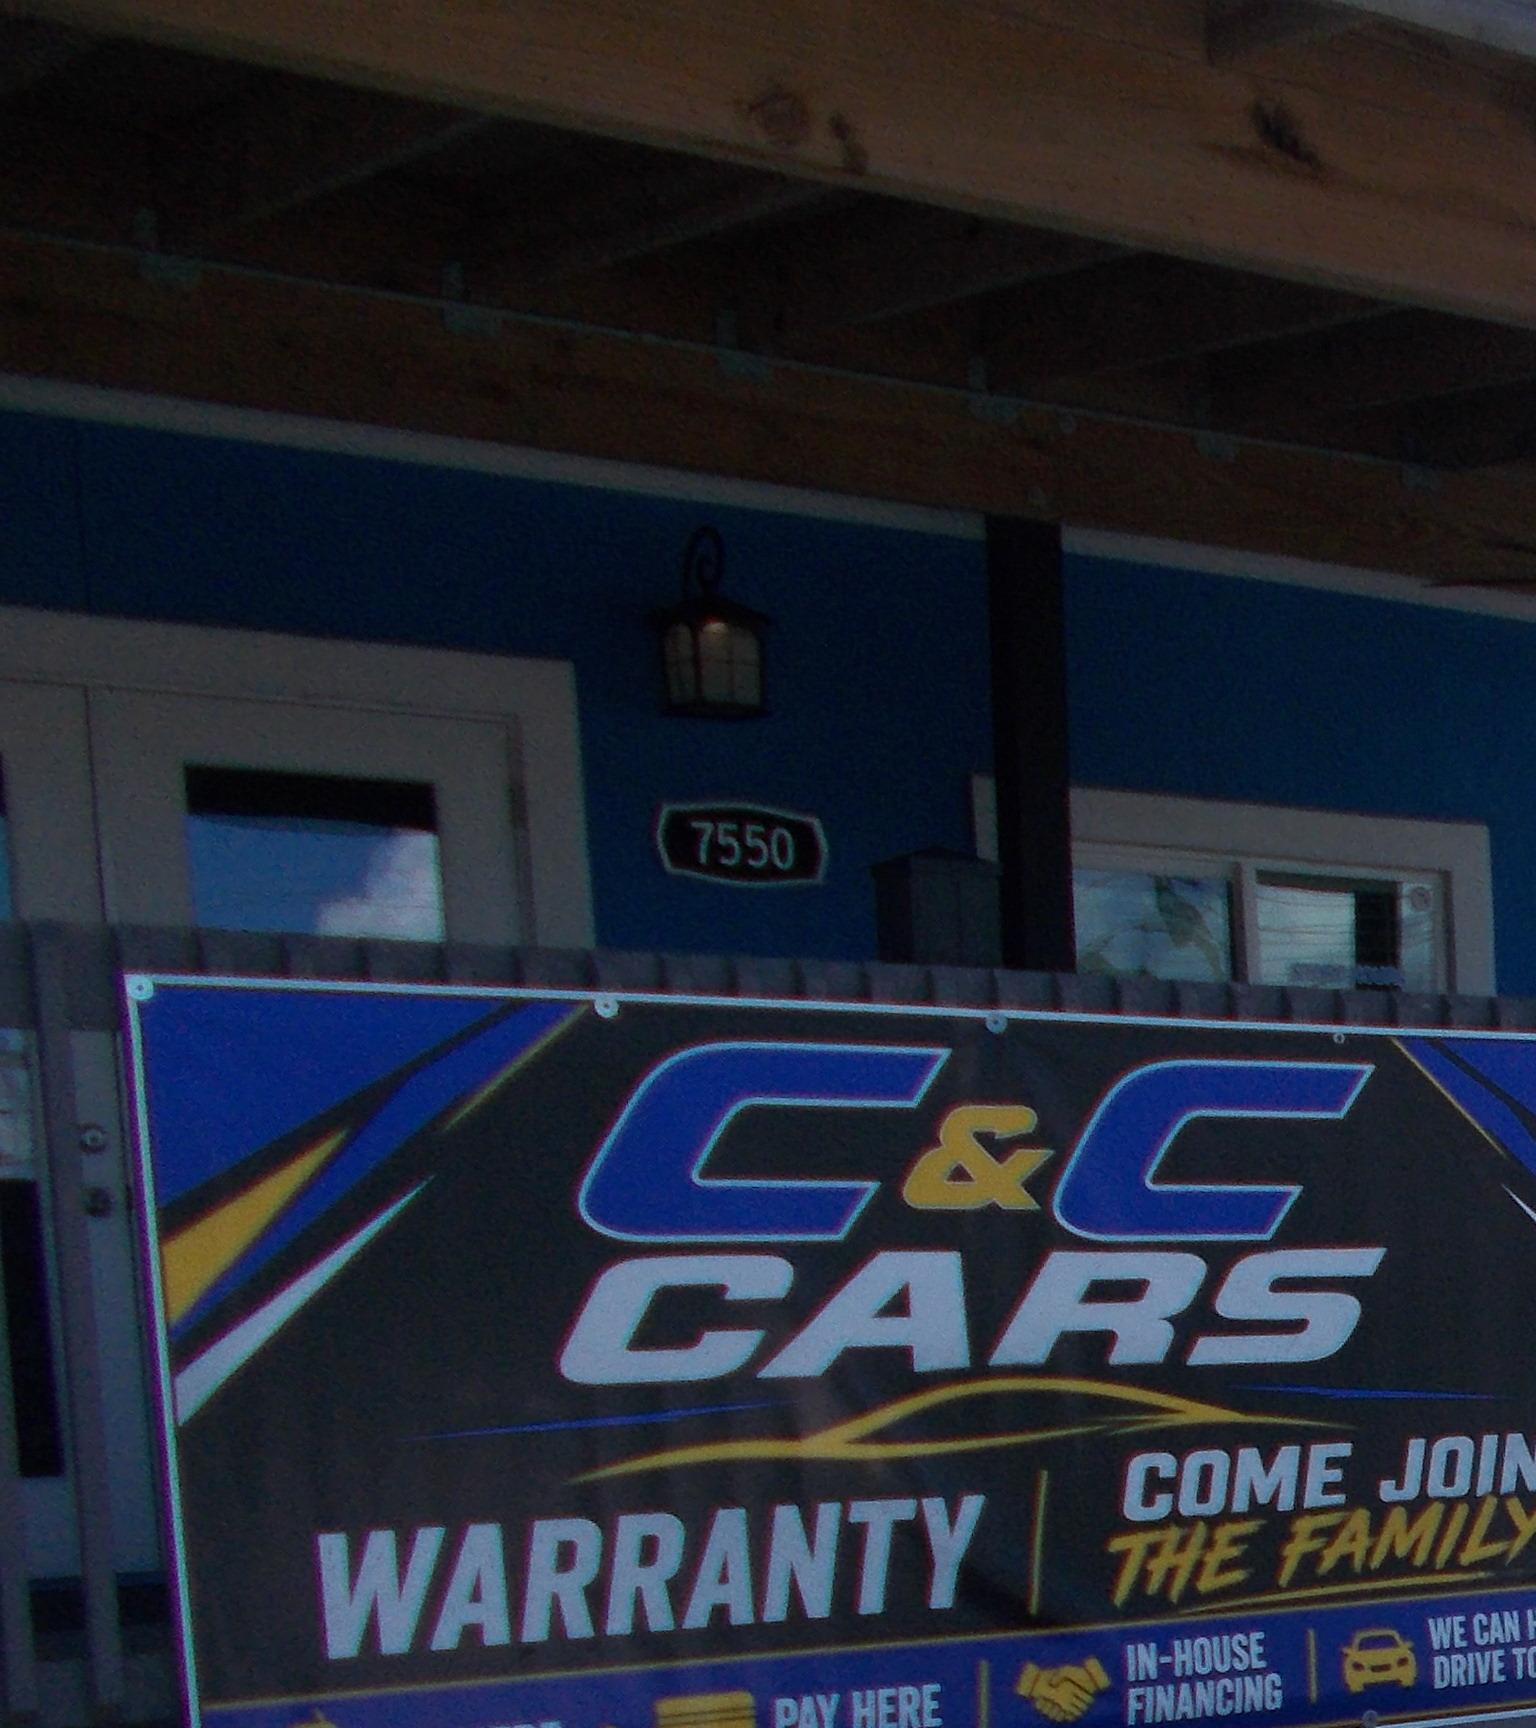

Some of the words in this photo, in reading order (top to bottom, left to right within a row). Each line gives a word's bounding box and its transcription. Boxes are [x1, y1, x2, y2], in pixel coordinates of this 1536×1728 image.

[690, 821, 795, 871] 7550
[577, 1041, 1376, 1243] C&C
[559, 1247, 1387, 1385] CARS
[1121, 1442, 1353, 1522] COME
[316, 1494, 986, 1661] WARRANTY
[1107, 1517, 1267, 1609] THE
[1126, 1632, 1267, 1682] IN-HOUSE
[1428, 1613, 1467, 1650] WE
[1472, 1606, 1522, 1645] CAN
[1127, 1673, 1283, 1726] FINANCING
[1432, 1647, 1507, 1690] DRIVE
